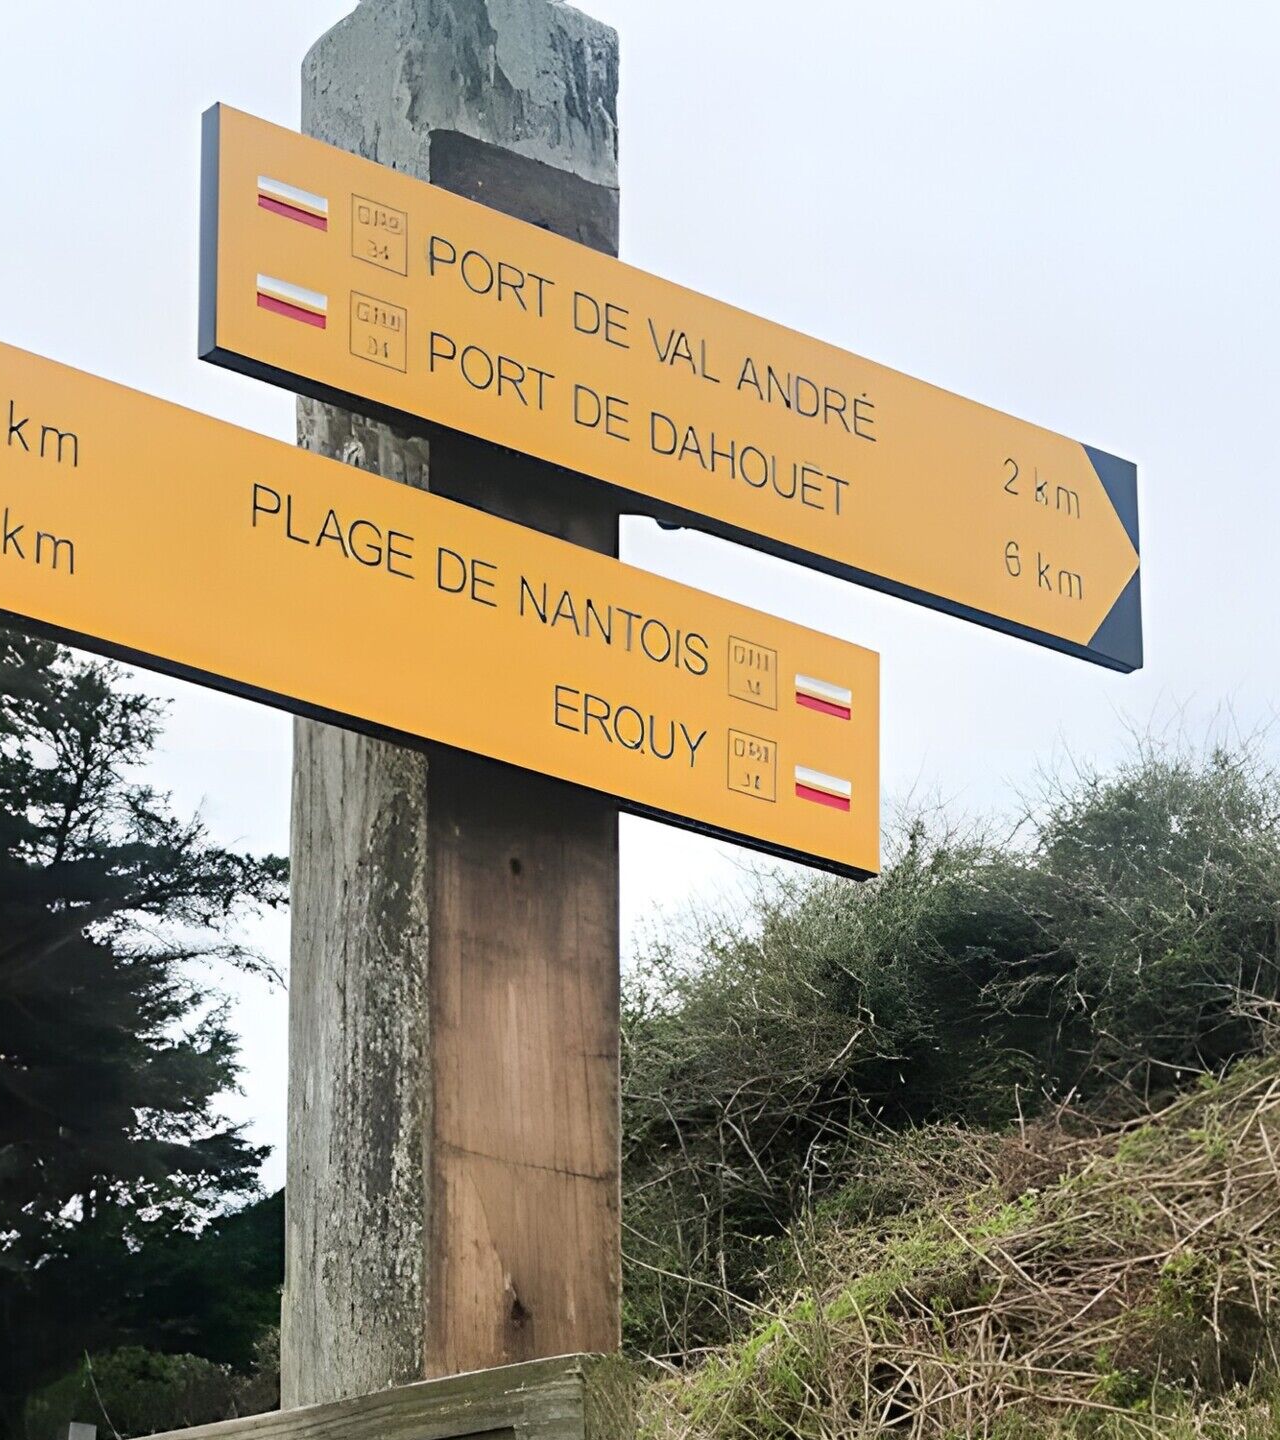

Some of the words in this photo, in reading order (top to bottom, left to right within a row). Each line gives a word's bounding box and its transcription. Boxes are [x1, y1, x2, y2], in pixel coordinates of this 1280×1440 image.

[429, 235, 555, 318] PORT
[573, 290, 630, 349] DE
[647, 317, 721, 383] VAL
[737, 356, 877, 442] ANDRÉ
[429, 330, 555, 411] PORT
[573, 383, 631, 441] DE
[7, 399, 78, 468] km
[1003, 457, 1019, 496] 2
[1034, 466, 1081, 519] km
[2, 506, 75, 575] km
[1004, 540, 1021, 577] 6
[1037, 551, 1082, 600] km
[252, 483, 415, 580] PLAGE
[437, 546, 498, 608] DE
[519, 575, 710, 677] NANTOIS
[553, 684, 708, 768] ERQUY
